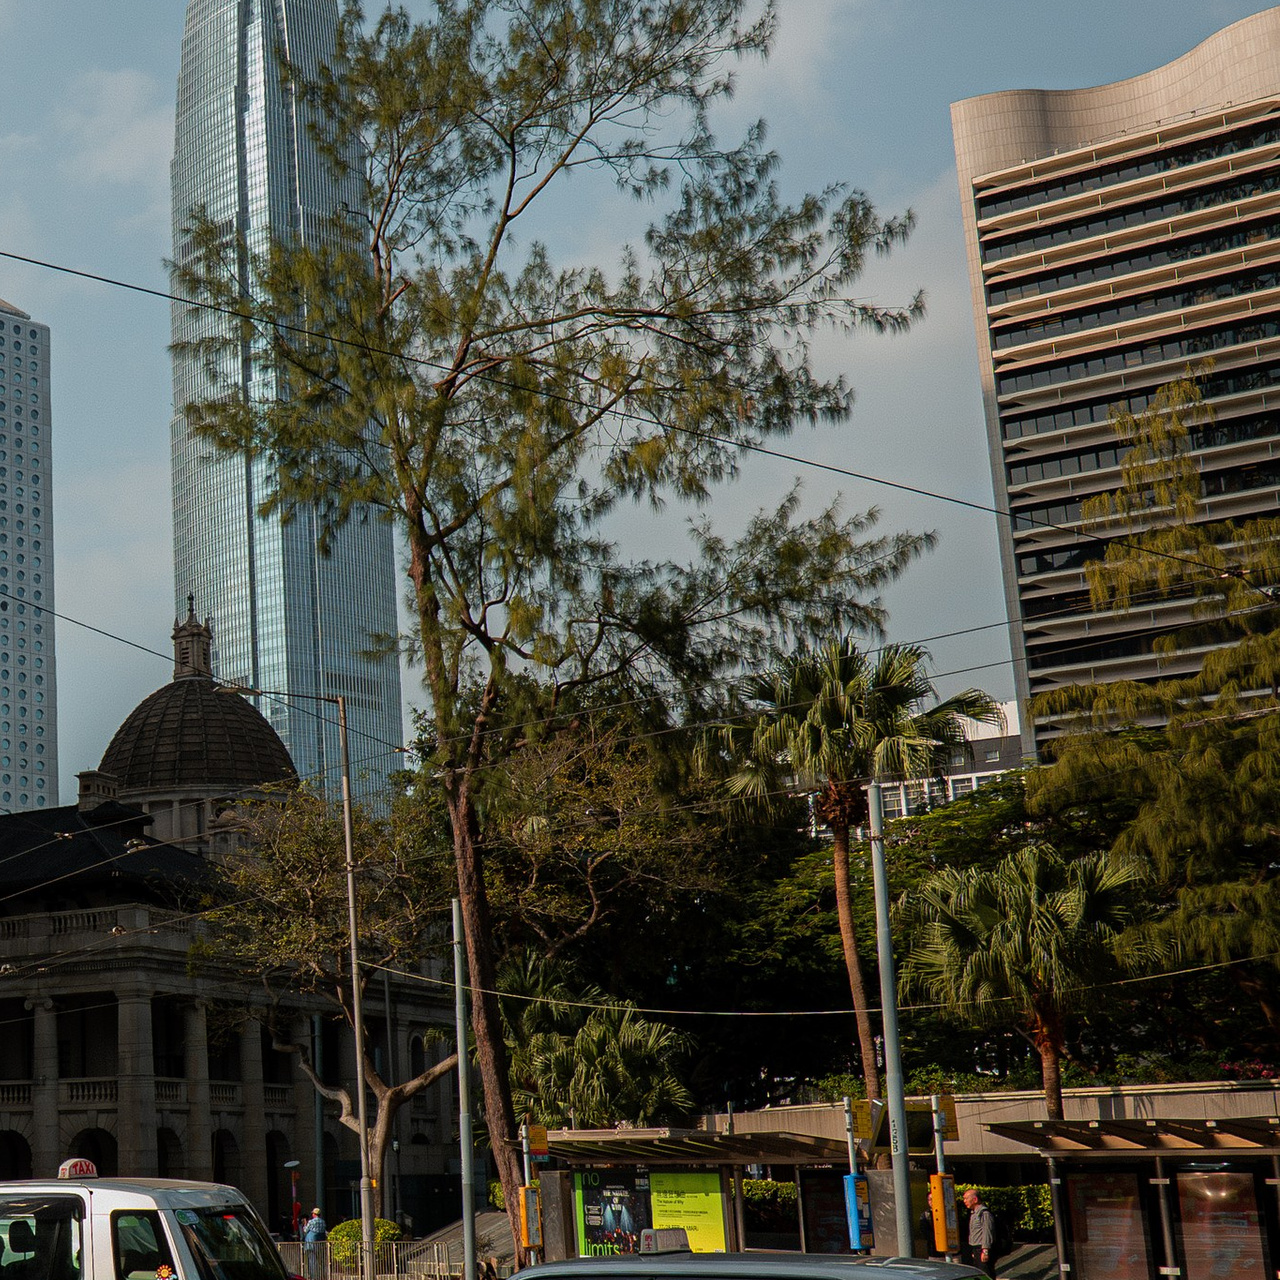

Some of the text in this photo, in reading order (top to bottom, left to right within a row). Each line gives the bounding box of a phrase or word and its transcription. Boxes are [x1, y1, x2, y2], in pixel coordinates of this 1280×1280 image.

[72, 1160, 95, 1175] TAXI
[582, 1172, 600, 1187] no
[586, 1239, 621, 1257] limits
